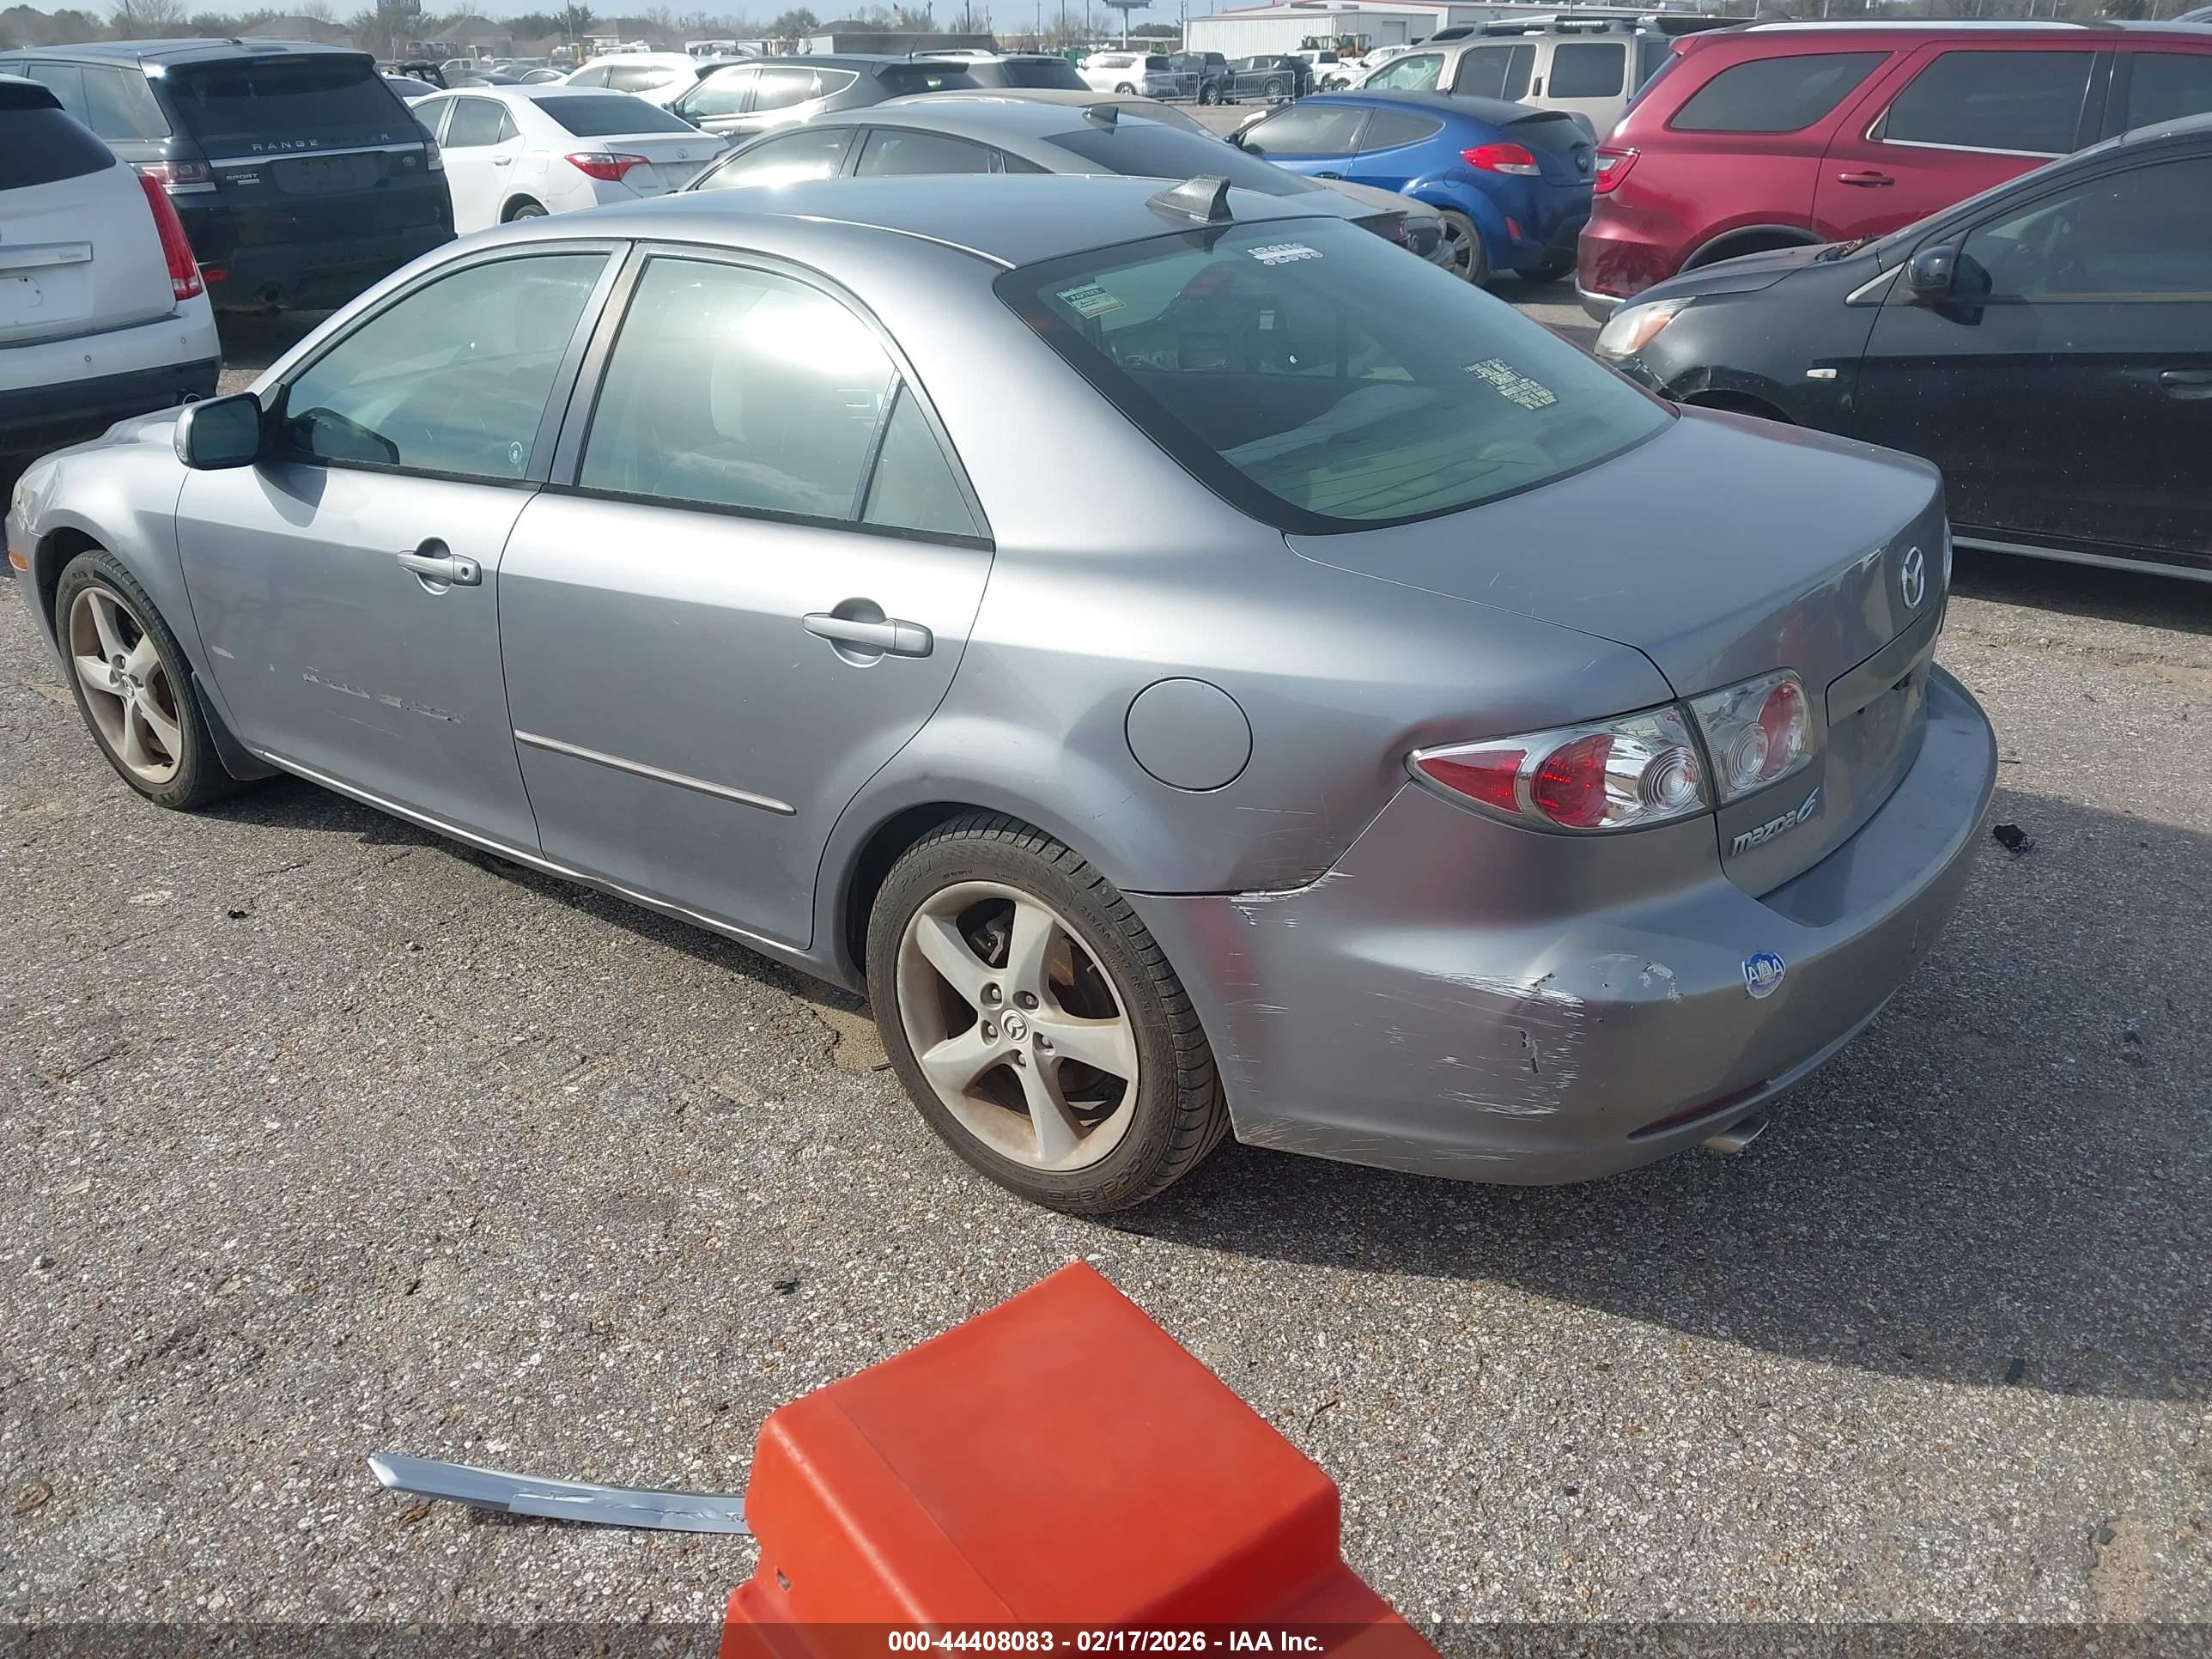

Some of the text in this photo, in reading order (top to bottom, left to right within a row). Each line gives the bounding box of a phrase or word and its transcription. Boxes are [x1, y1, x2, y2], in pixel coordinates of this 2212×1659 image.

[252, 138, 319, 152] RANGE
[226, 173, 258, 181] SPORT
[1747, 957, 1784, 985] AAA
